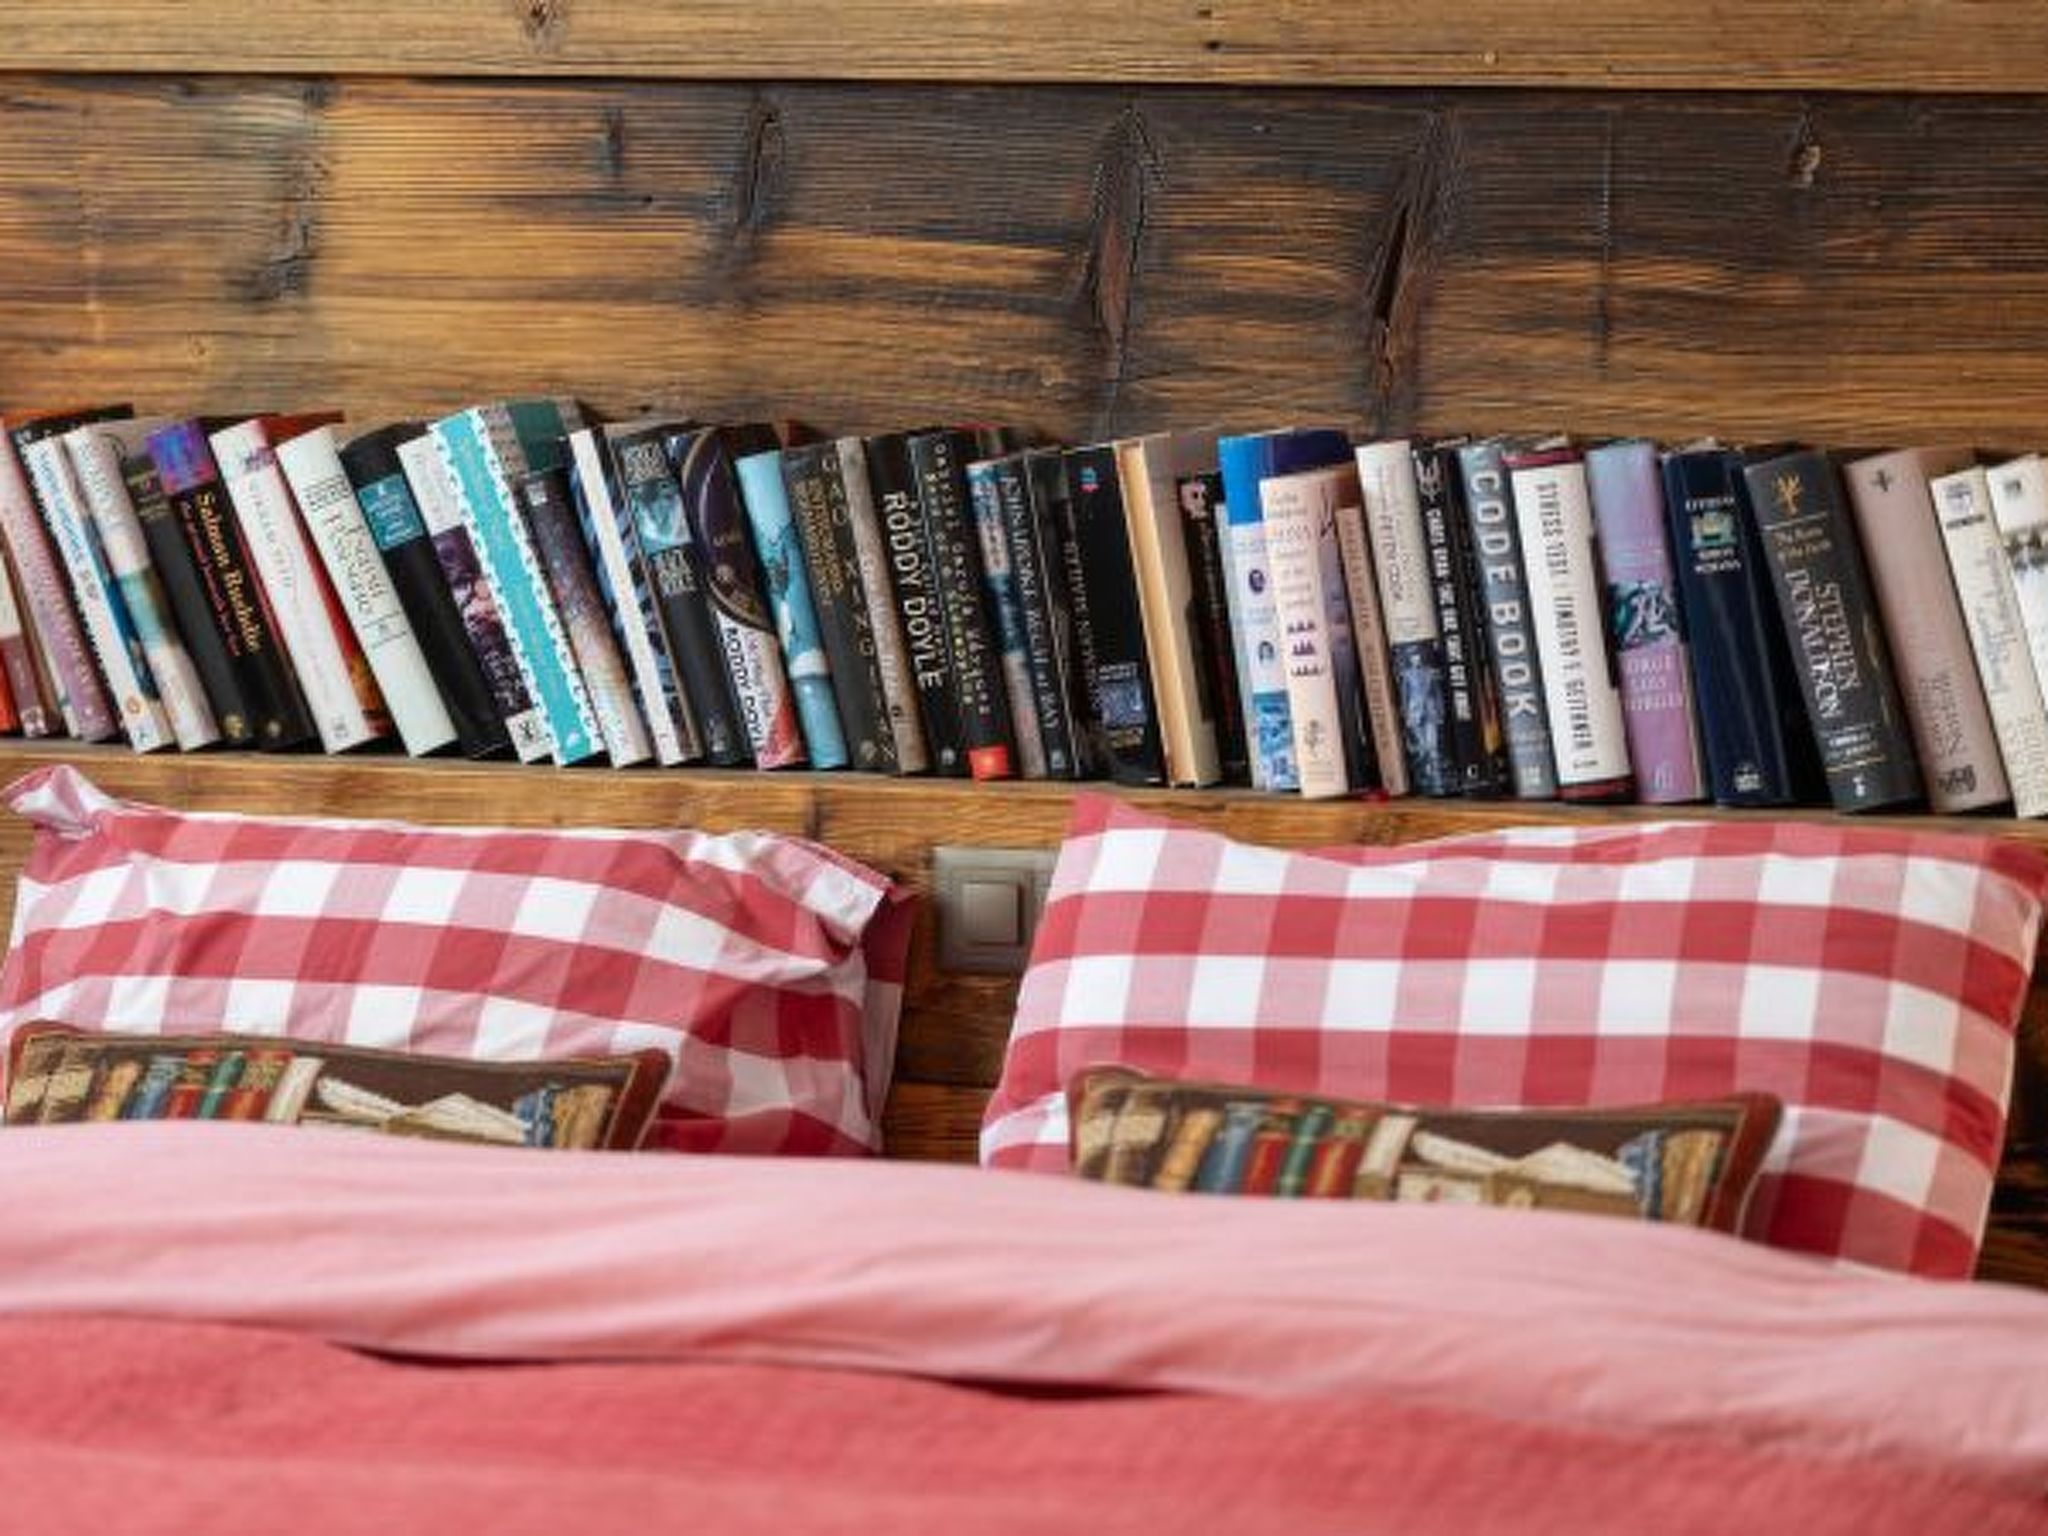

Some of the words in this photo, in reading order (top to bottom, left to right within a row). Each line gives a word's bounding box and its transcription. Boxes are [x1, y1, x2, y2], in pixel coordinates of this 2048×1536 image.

[198, 492, 230, 568] Salman
[224, 570, 261, 650] Rushdie
[883, 491, 922, 587] RODDY
[903, 596, 943, 689] DOYLE
[1471, 470, 1516, 584] CODE
[1491, 600, 1538, 718] BOOK
[1785, 568, 1842, 720] DONALDSON
[1815, 582, 1861, 690] STEPHEN
